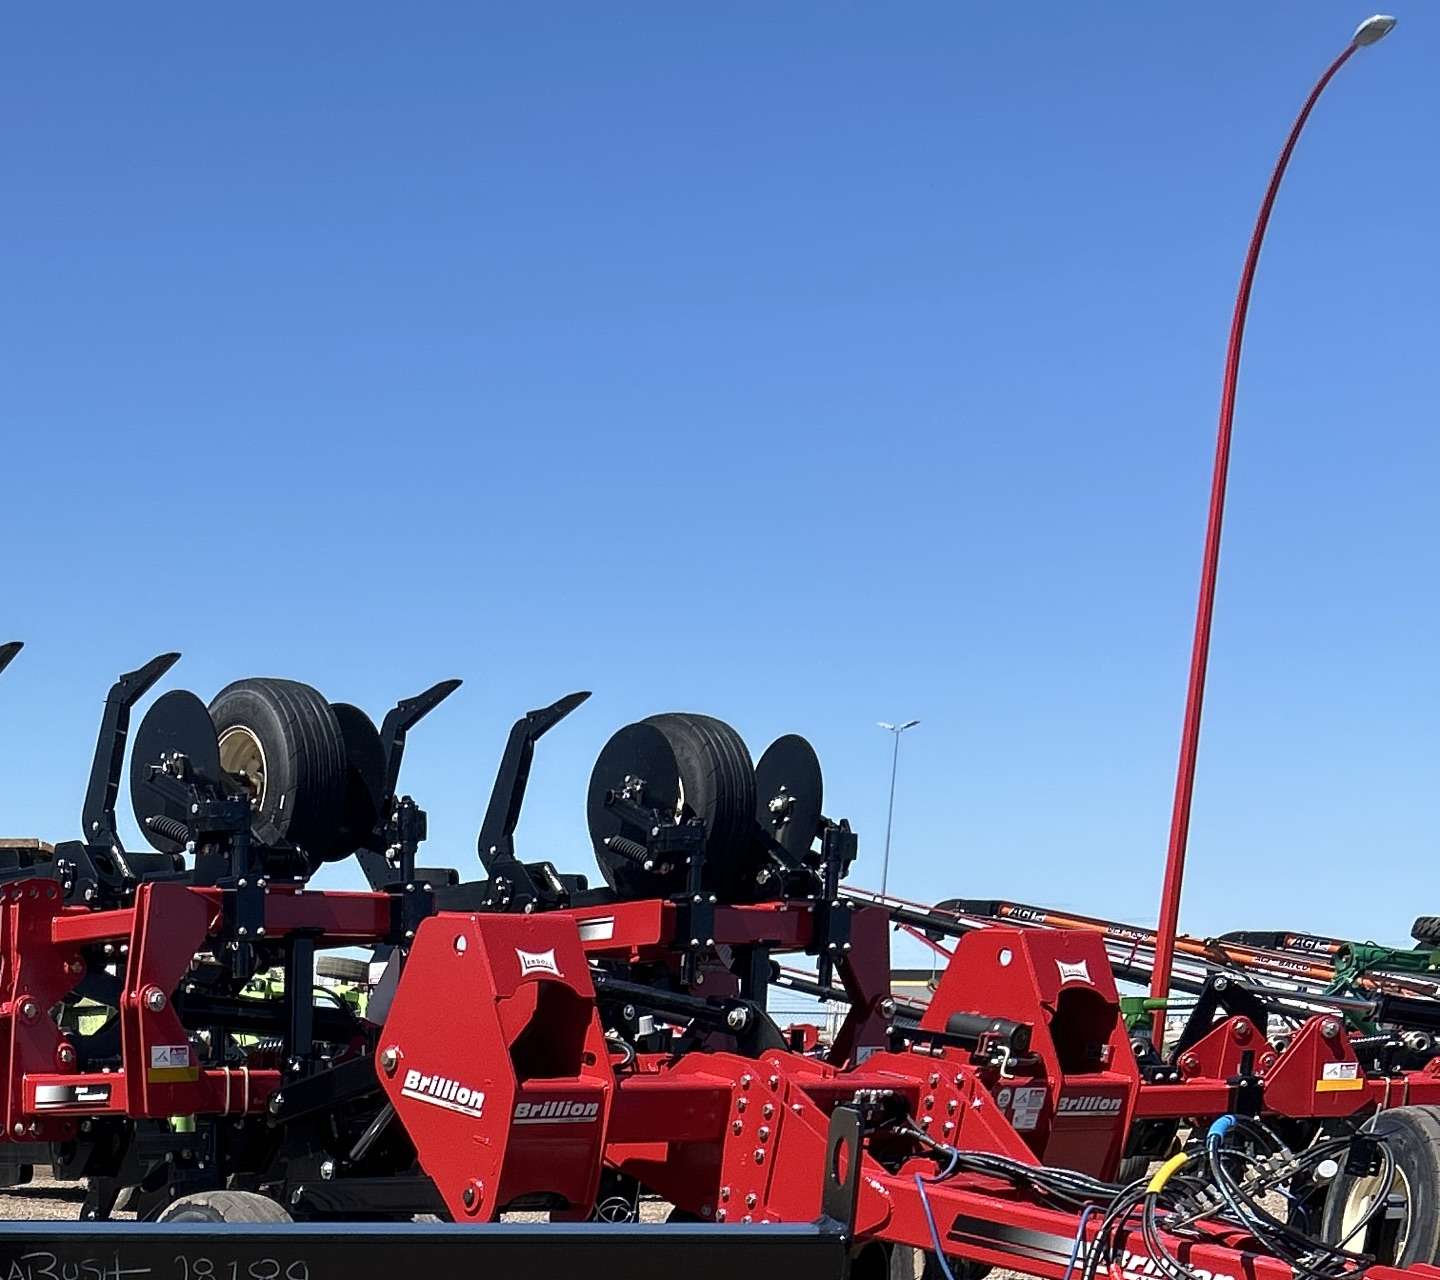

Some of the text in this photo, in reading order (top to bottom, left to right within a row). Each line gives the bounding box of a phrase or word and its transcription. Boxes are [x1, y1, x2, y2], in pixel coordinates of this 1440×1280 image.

[403, 1069, 485, 1110] Brillion
[513, 1100, 599, 1118] Brillion
[1058, 1095, 1123, 1111] Brillion
